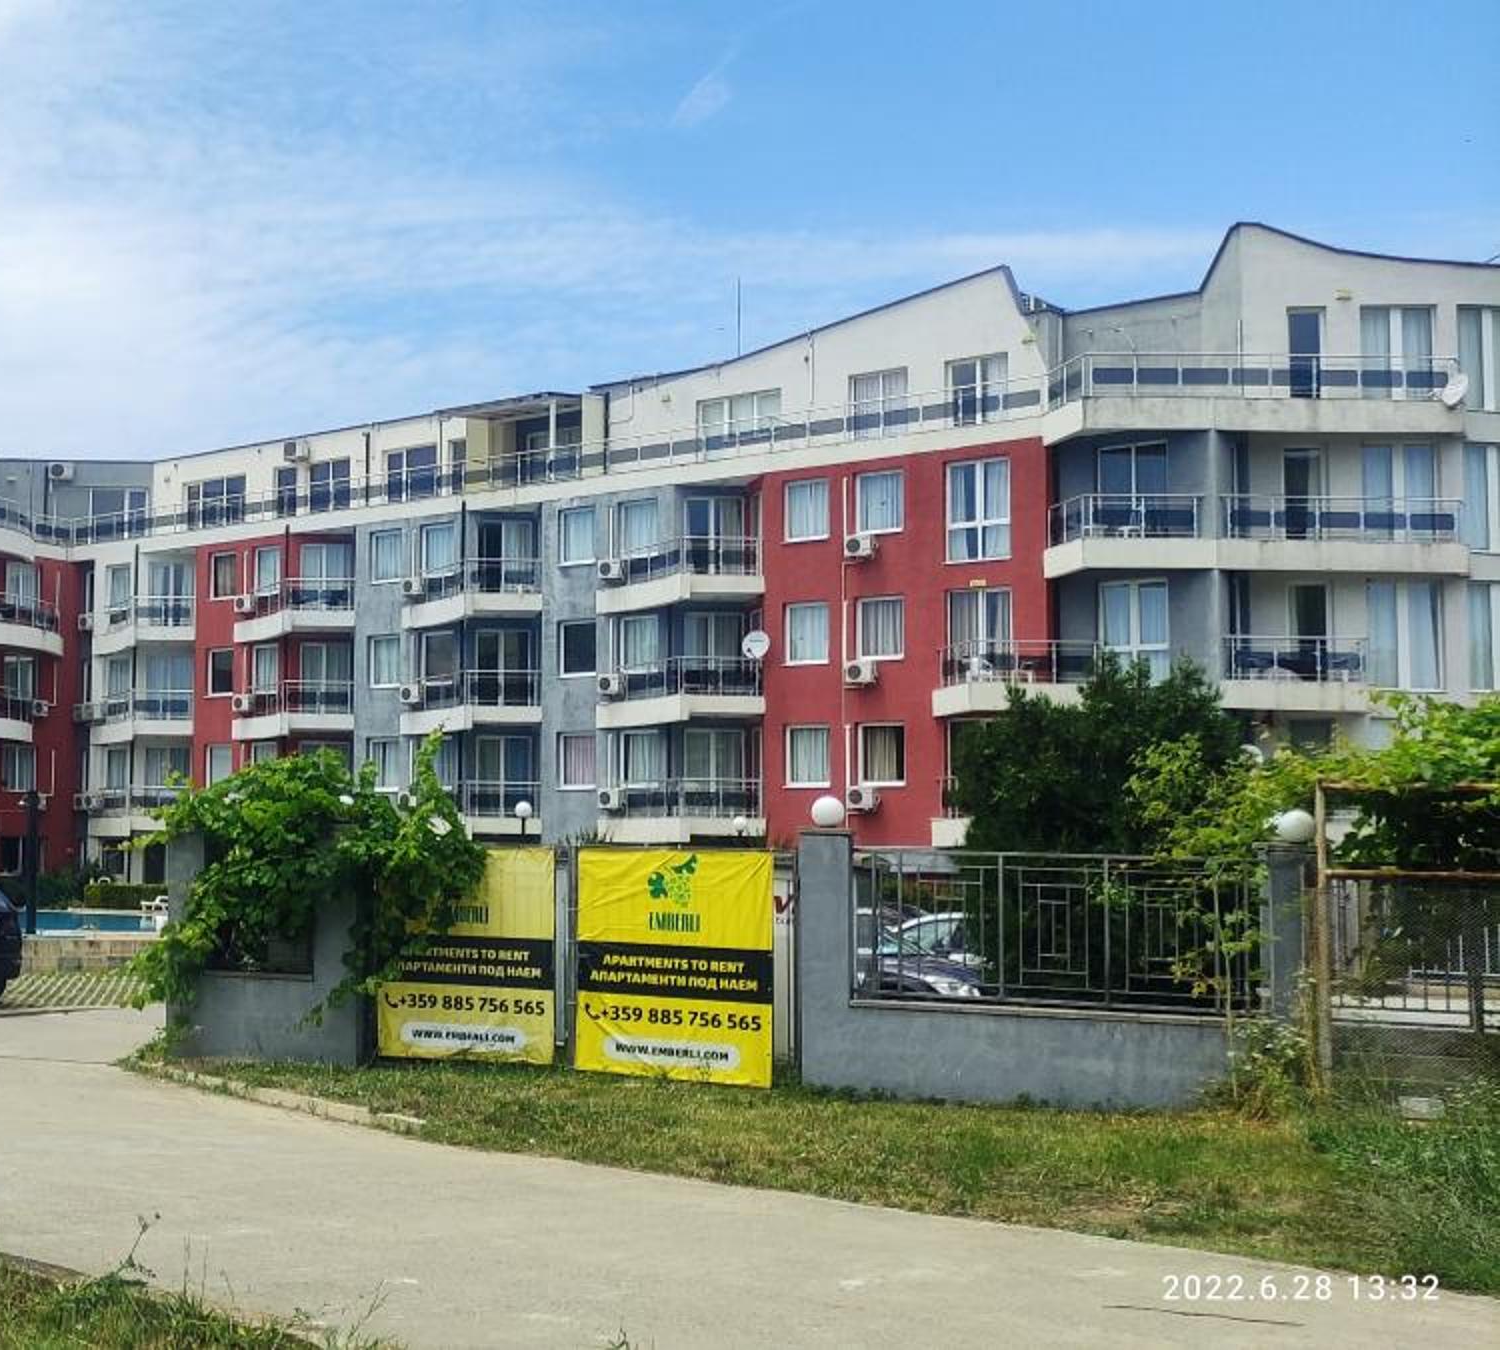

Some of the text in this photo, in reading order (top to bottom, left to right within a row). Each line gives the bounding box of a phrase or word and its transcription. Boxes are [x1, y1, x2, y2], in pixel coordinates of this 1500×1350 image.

[649, 911, 701, 932] EMBERLI
[480, 949, 497, 960] TO
[498, 950, 531, 962] RENT
[603, 954, 745, 974] APARTMENTS TO RENT
[478, 965, 505, 978] ПОД
[507, 967, 542, 979] НАЕМ
[590, 970, 758, 992] АПАРТАМЕНТИ ПОД НАЕМ
[398, 993, 545, 1016] +359 885 756 565
[601, 1005, 761, 1031] +359 885 756 565
[615, 1041, 729, 1061] WWW.EMBERLI.COM
